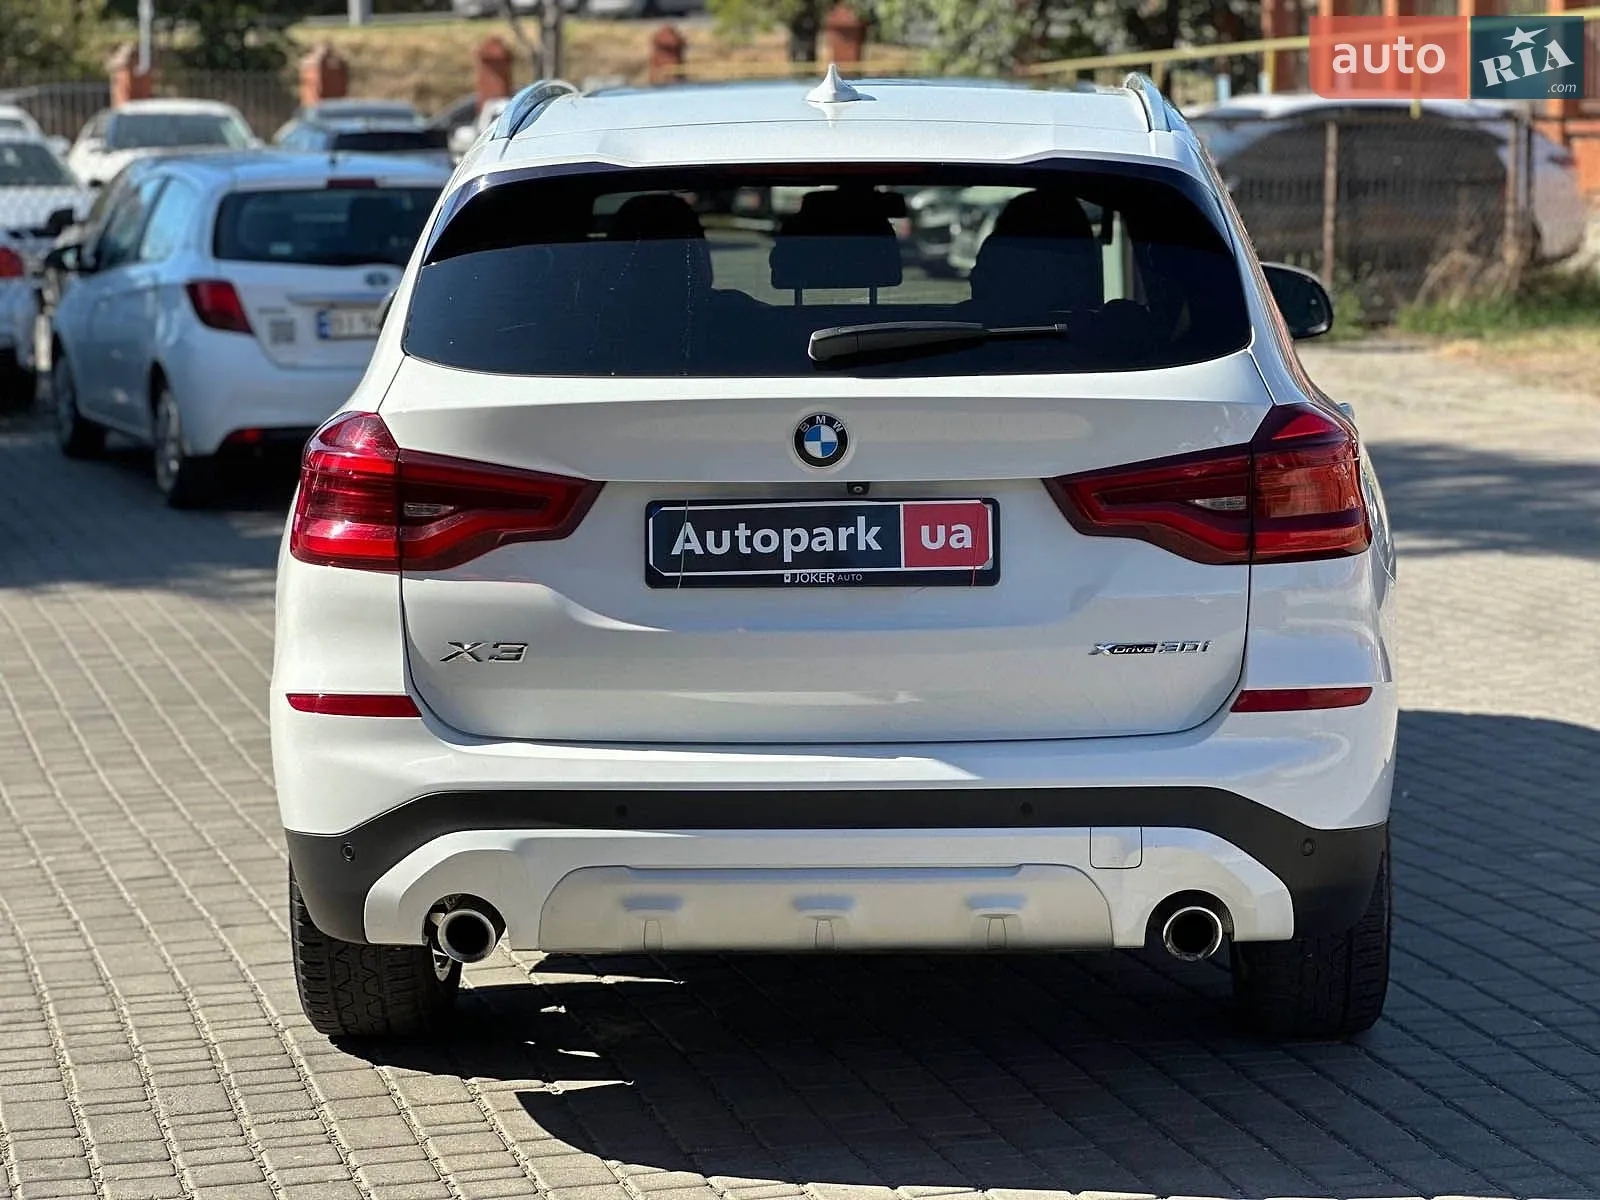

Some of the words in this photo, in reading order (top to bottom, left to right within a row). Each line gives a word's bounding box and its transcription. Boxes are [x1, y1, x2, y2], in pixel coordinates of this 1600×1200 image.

[800, 415, 844, 433] BMW
[671, 516, 882, 562] Autopark
[920, 524, 972, 549] ua
[795, 572, 835, 583] JOKER
[837, 573, 863, 581] AUTO
[440, 642, 528, 663] X3
